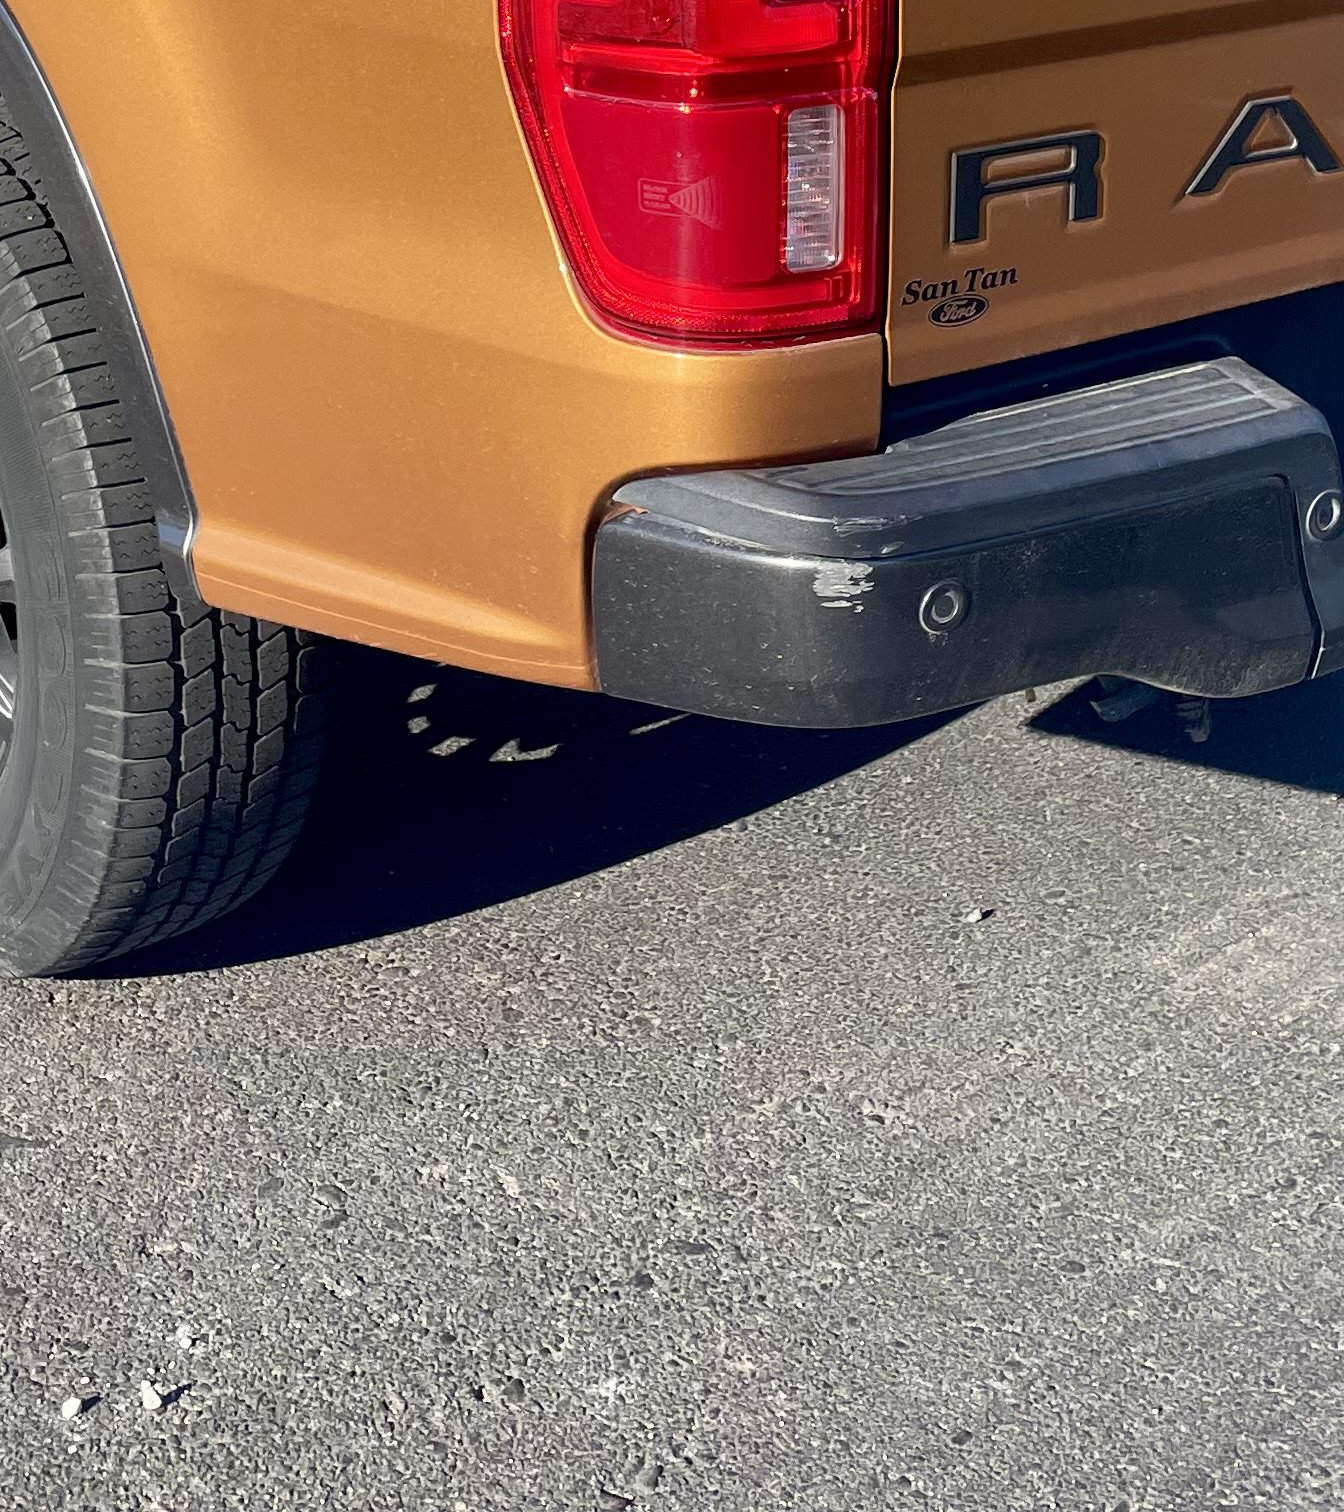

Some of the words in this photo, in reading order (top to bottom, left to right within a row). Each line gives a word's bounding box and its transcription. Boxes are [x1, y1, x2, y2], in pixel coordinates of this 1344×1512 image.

[901, 279, 959, 306] San
[964, 267, 1018, 292] Tan
[939, 299, 977, 322] Ford
